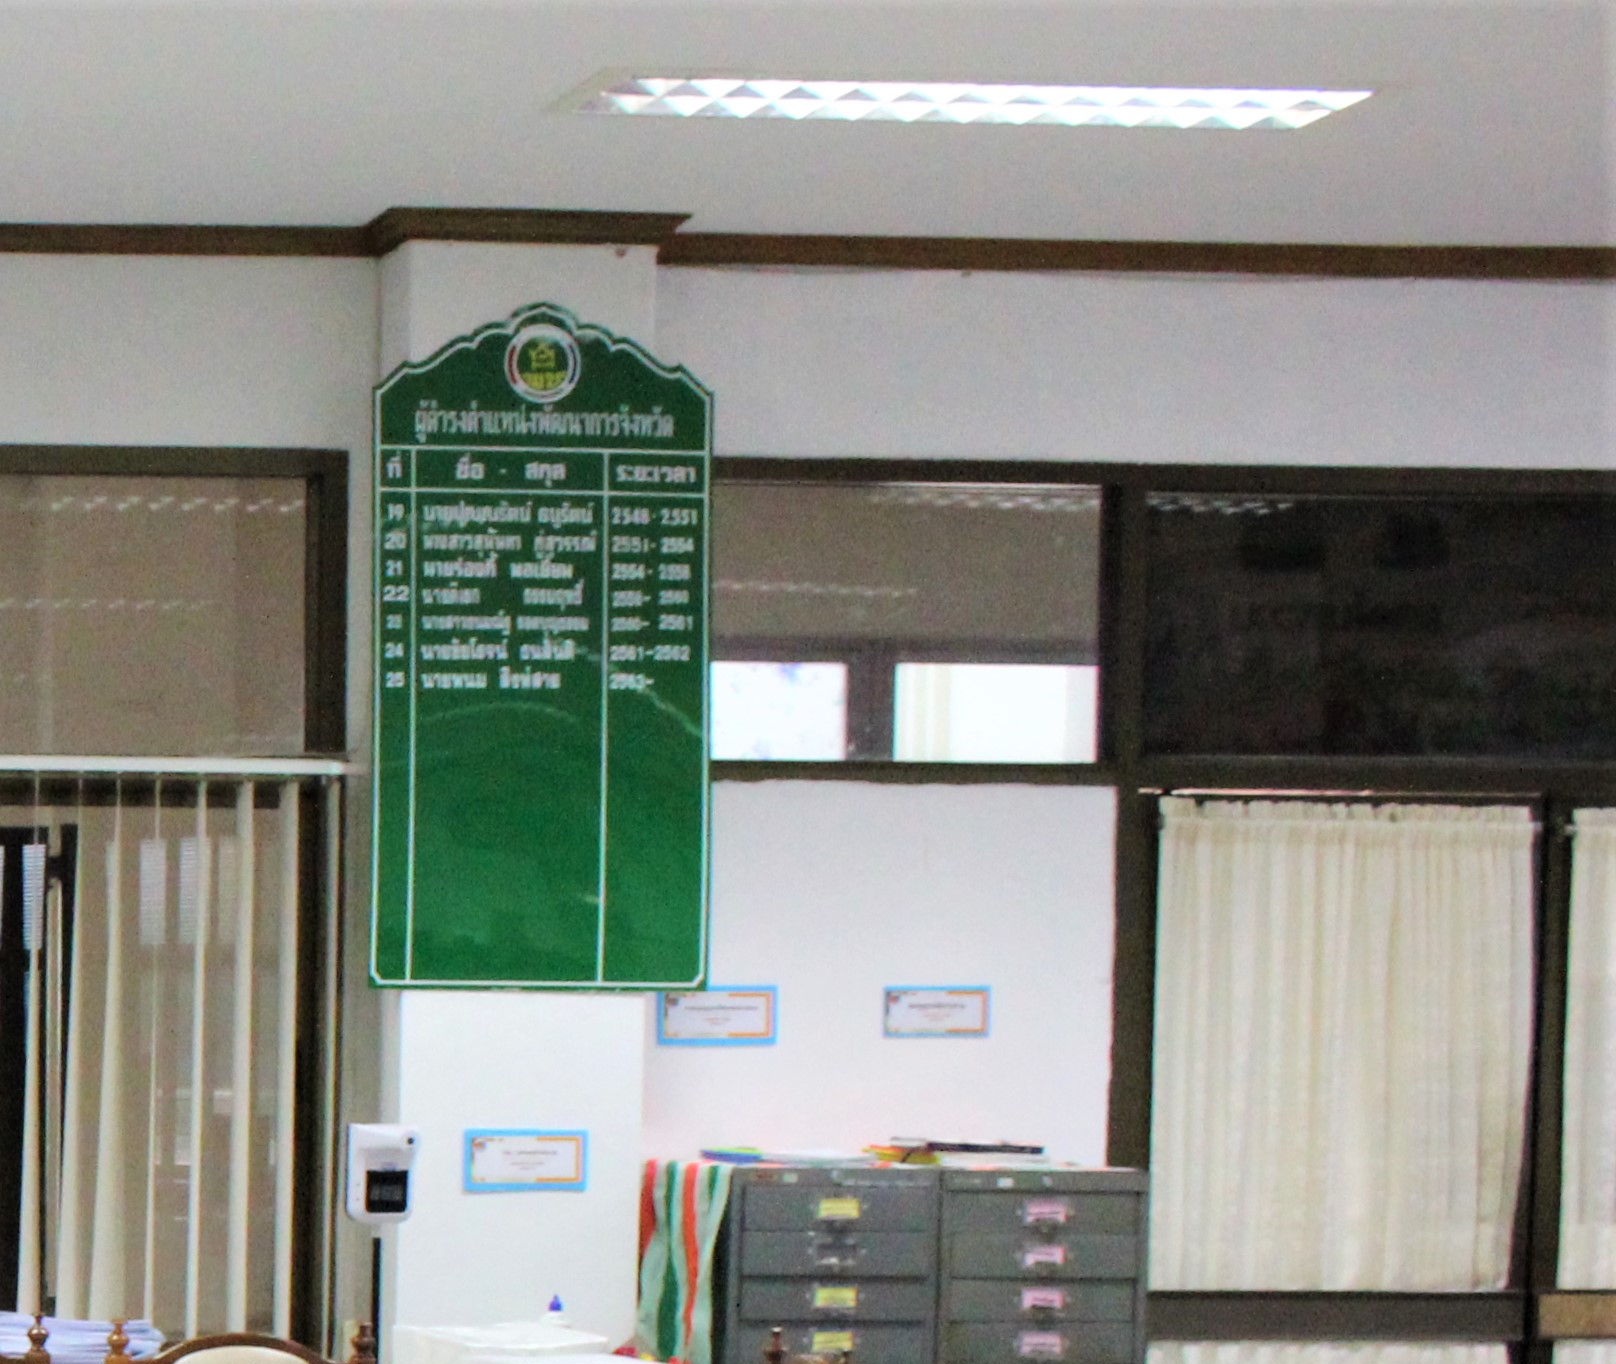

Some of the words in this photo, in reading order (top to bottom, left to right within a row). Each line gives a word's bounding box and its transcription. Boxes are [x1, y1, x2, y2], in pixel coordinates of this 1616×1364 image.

[388, 503, 404, 521] 19
[384, 532, 406, 549] 20
[386, 560, 403, 577] 21
[383, 586, 409, 602] 22
[385, 643, 404, 659] 24
[386, 671, 405, 688] 25
